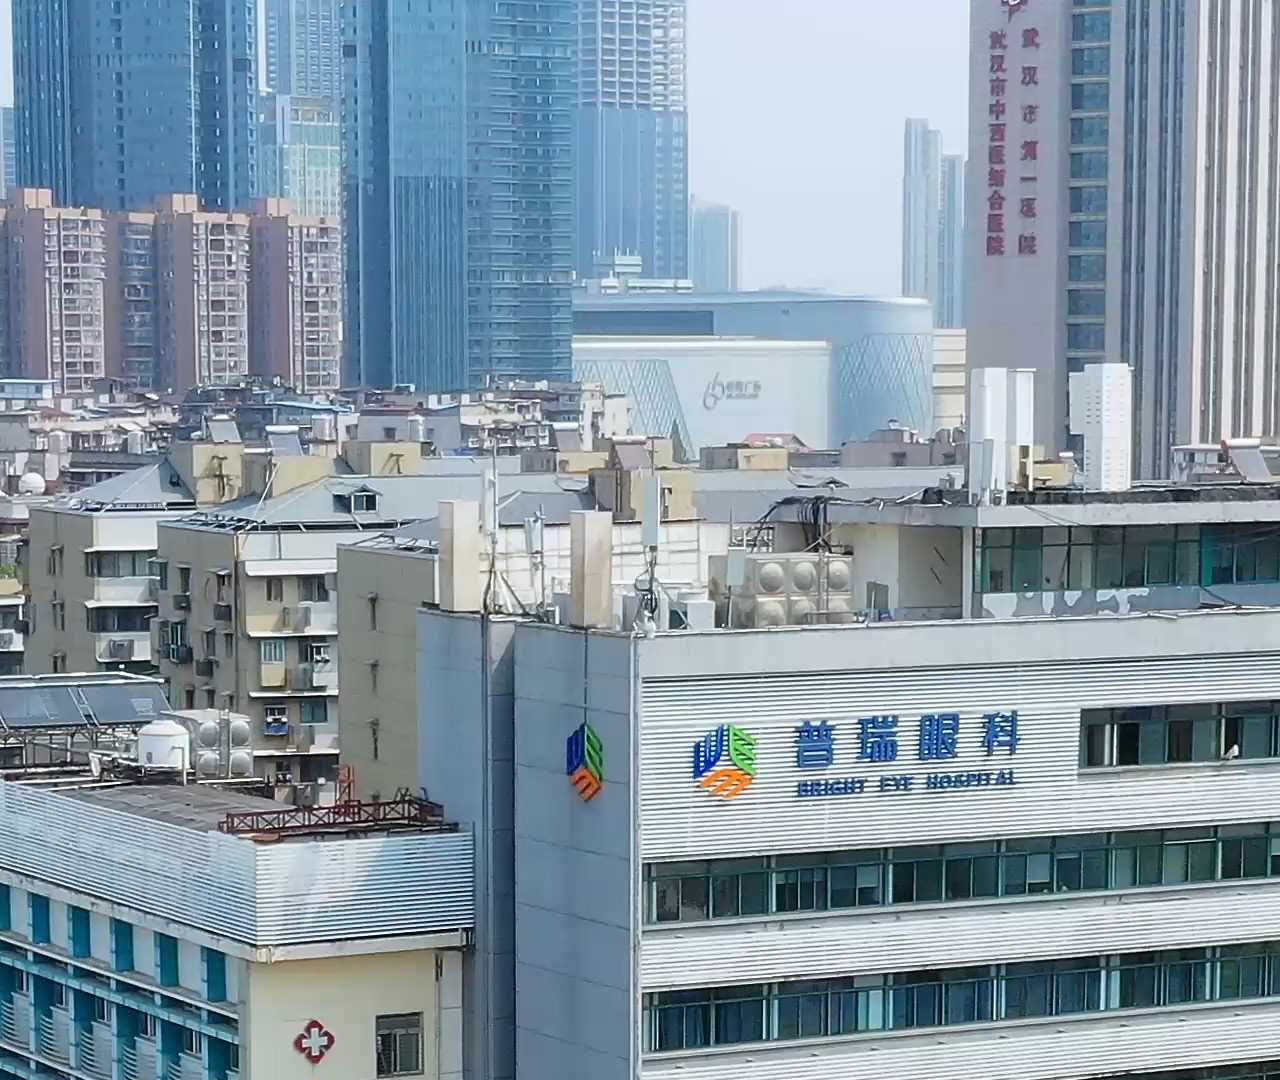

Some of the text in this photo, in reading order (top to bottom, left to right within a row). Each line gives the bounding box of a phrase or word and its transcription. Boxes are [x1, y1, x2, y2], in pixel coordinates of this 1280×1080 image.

[986, 29, 1008, 256] 武汉市中西医结合医院
[1018, 28, 1040, 256] 武汉市第一医院
[793, 710, 1020, 769] 普瑞眼科
[798, 768, 1016, 797] BRIGHT EYE HOSPITAL
